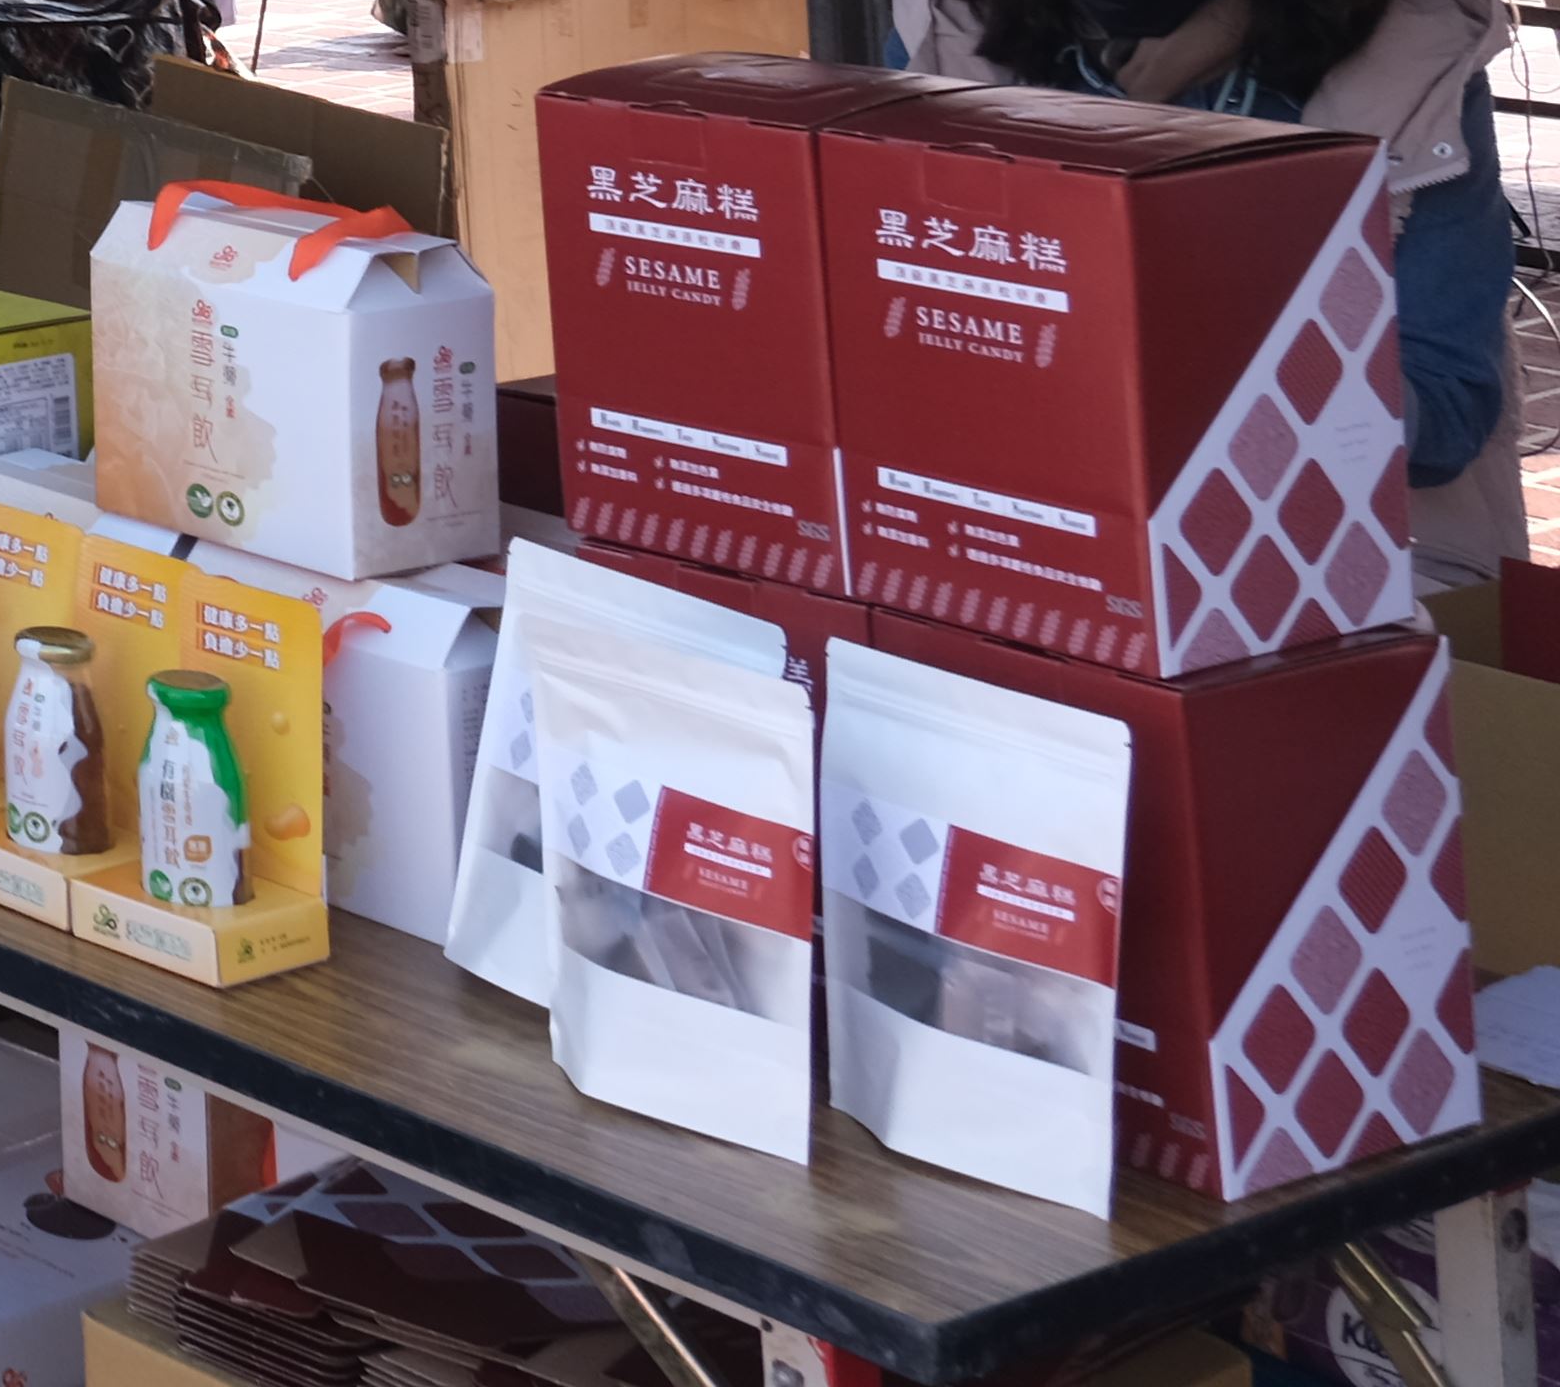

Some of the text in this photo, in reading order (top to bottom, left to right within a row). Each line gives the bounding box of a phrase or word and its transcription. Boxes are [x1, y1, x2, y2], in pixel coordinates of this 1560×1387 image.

[587, 165, 761, 223] 黑芝麻糕
[875, 207, 1068, 275] 黑芝麻糕
[624, 255, 722, 291] SESAME
[625, 279, 723, 308] JELLY CANDY
[915, 305, 1024, 346] SESAME
[918, 331, 1024, 364] JELLY CANDY
[797, 519, 831, 542] SGS
[1104, 593, 1144, 619] SGS
